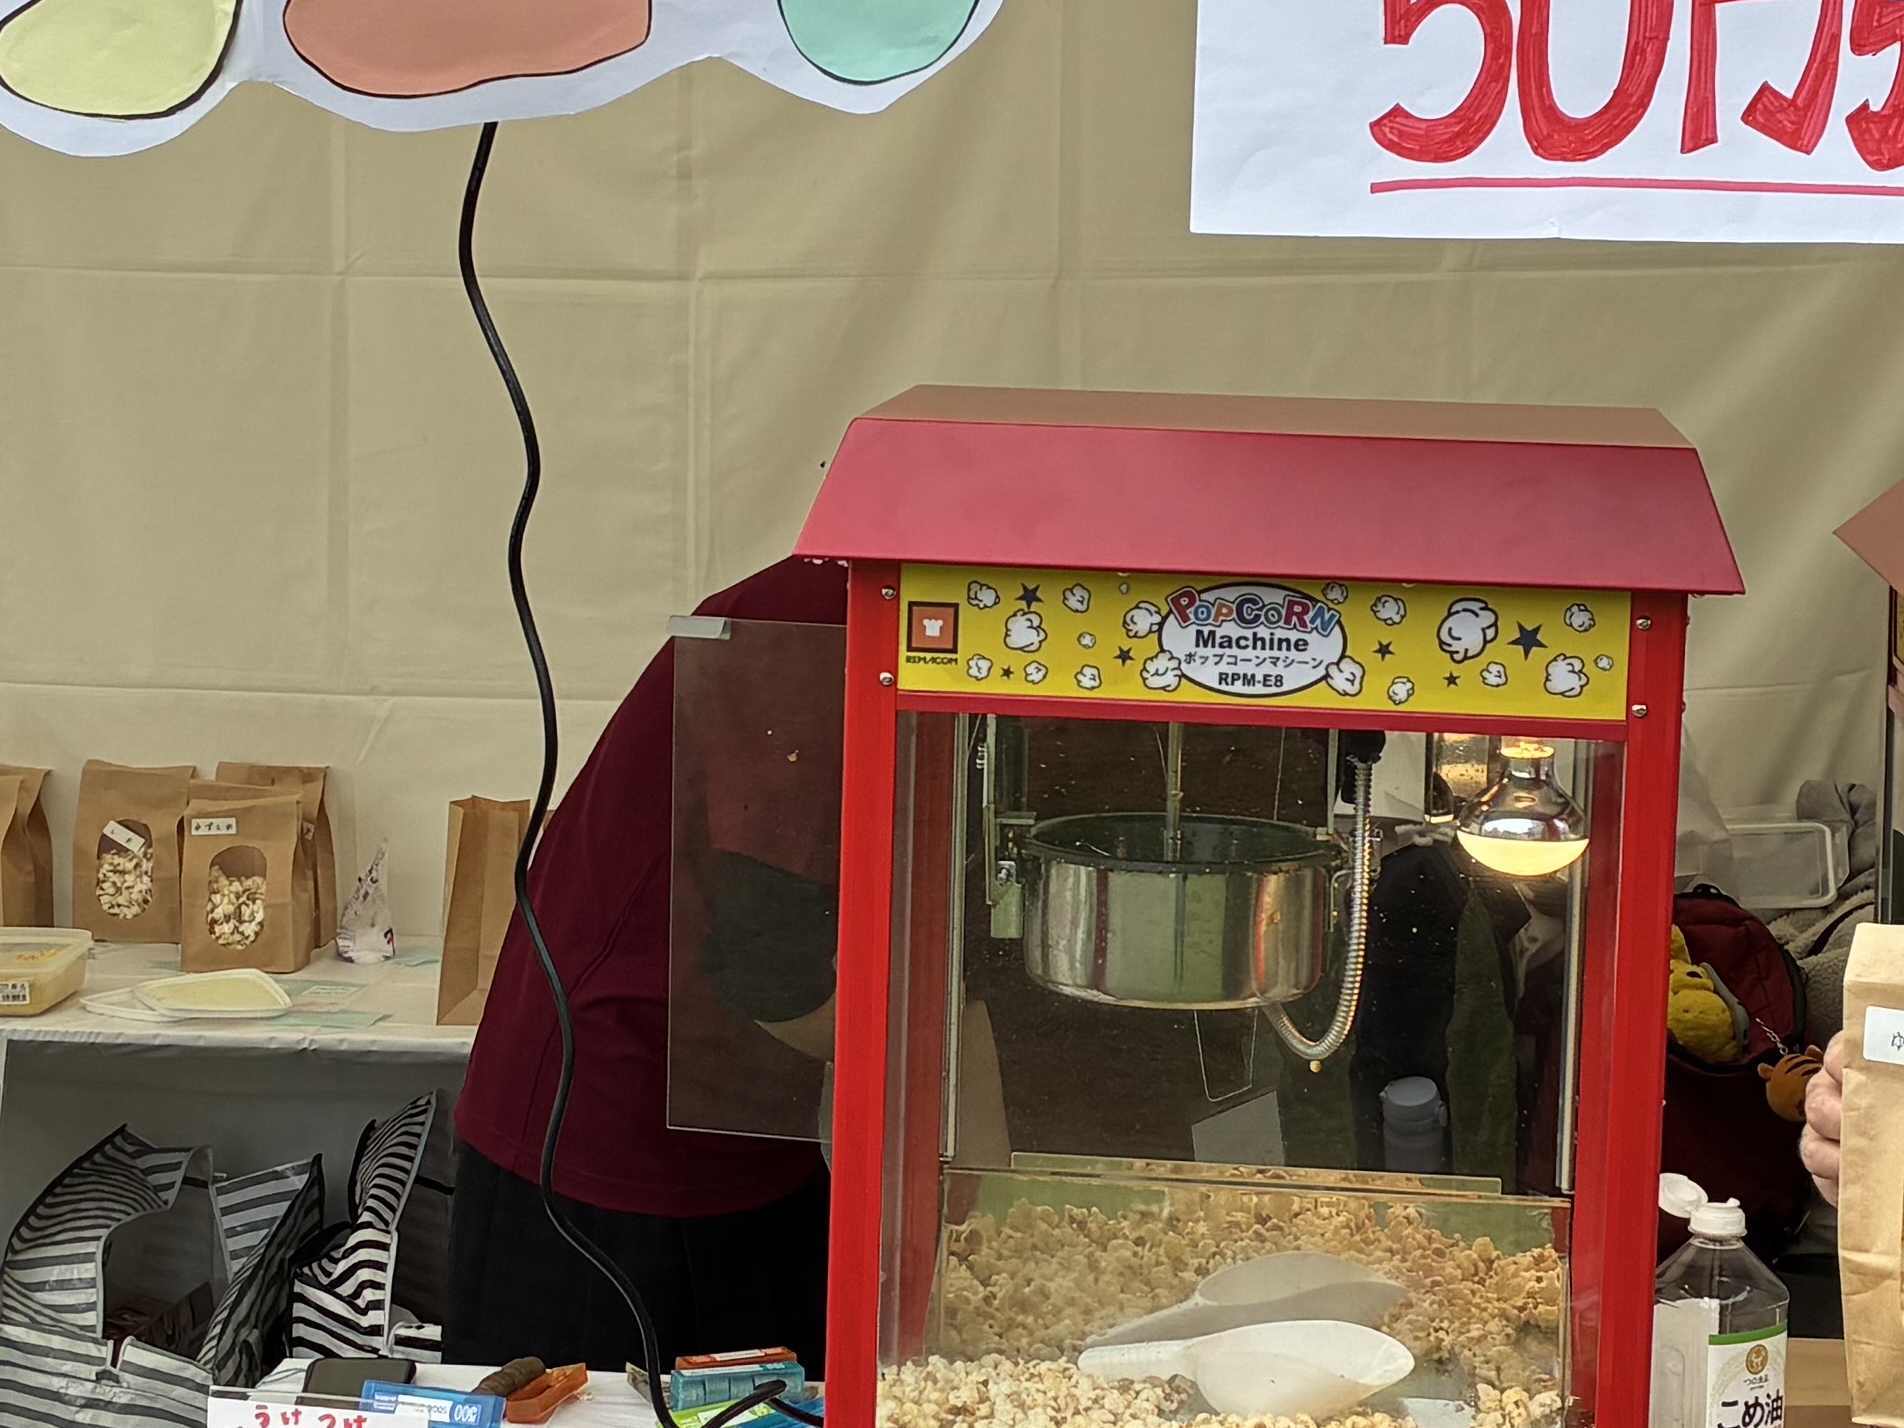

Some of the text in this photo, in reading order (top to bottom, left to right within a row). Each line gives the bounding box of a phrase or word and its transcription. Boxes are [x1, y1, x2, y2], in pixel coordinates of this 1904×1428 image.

[1166, 586, 1342, 637] POPCORN
[1195, 630, 1309, 652] Machine
[1184, 652, 1324, 670] ポップコーンマシーン
[1218, 672, 1284, 688] RPM-E8
